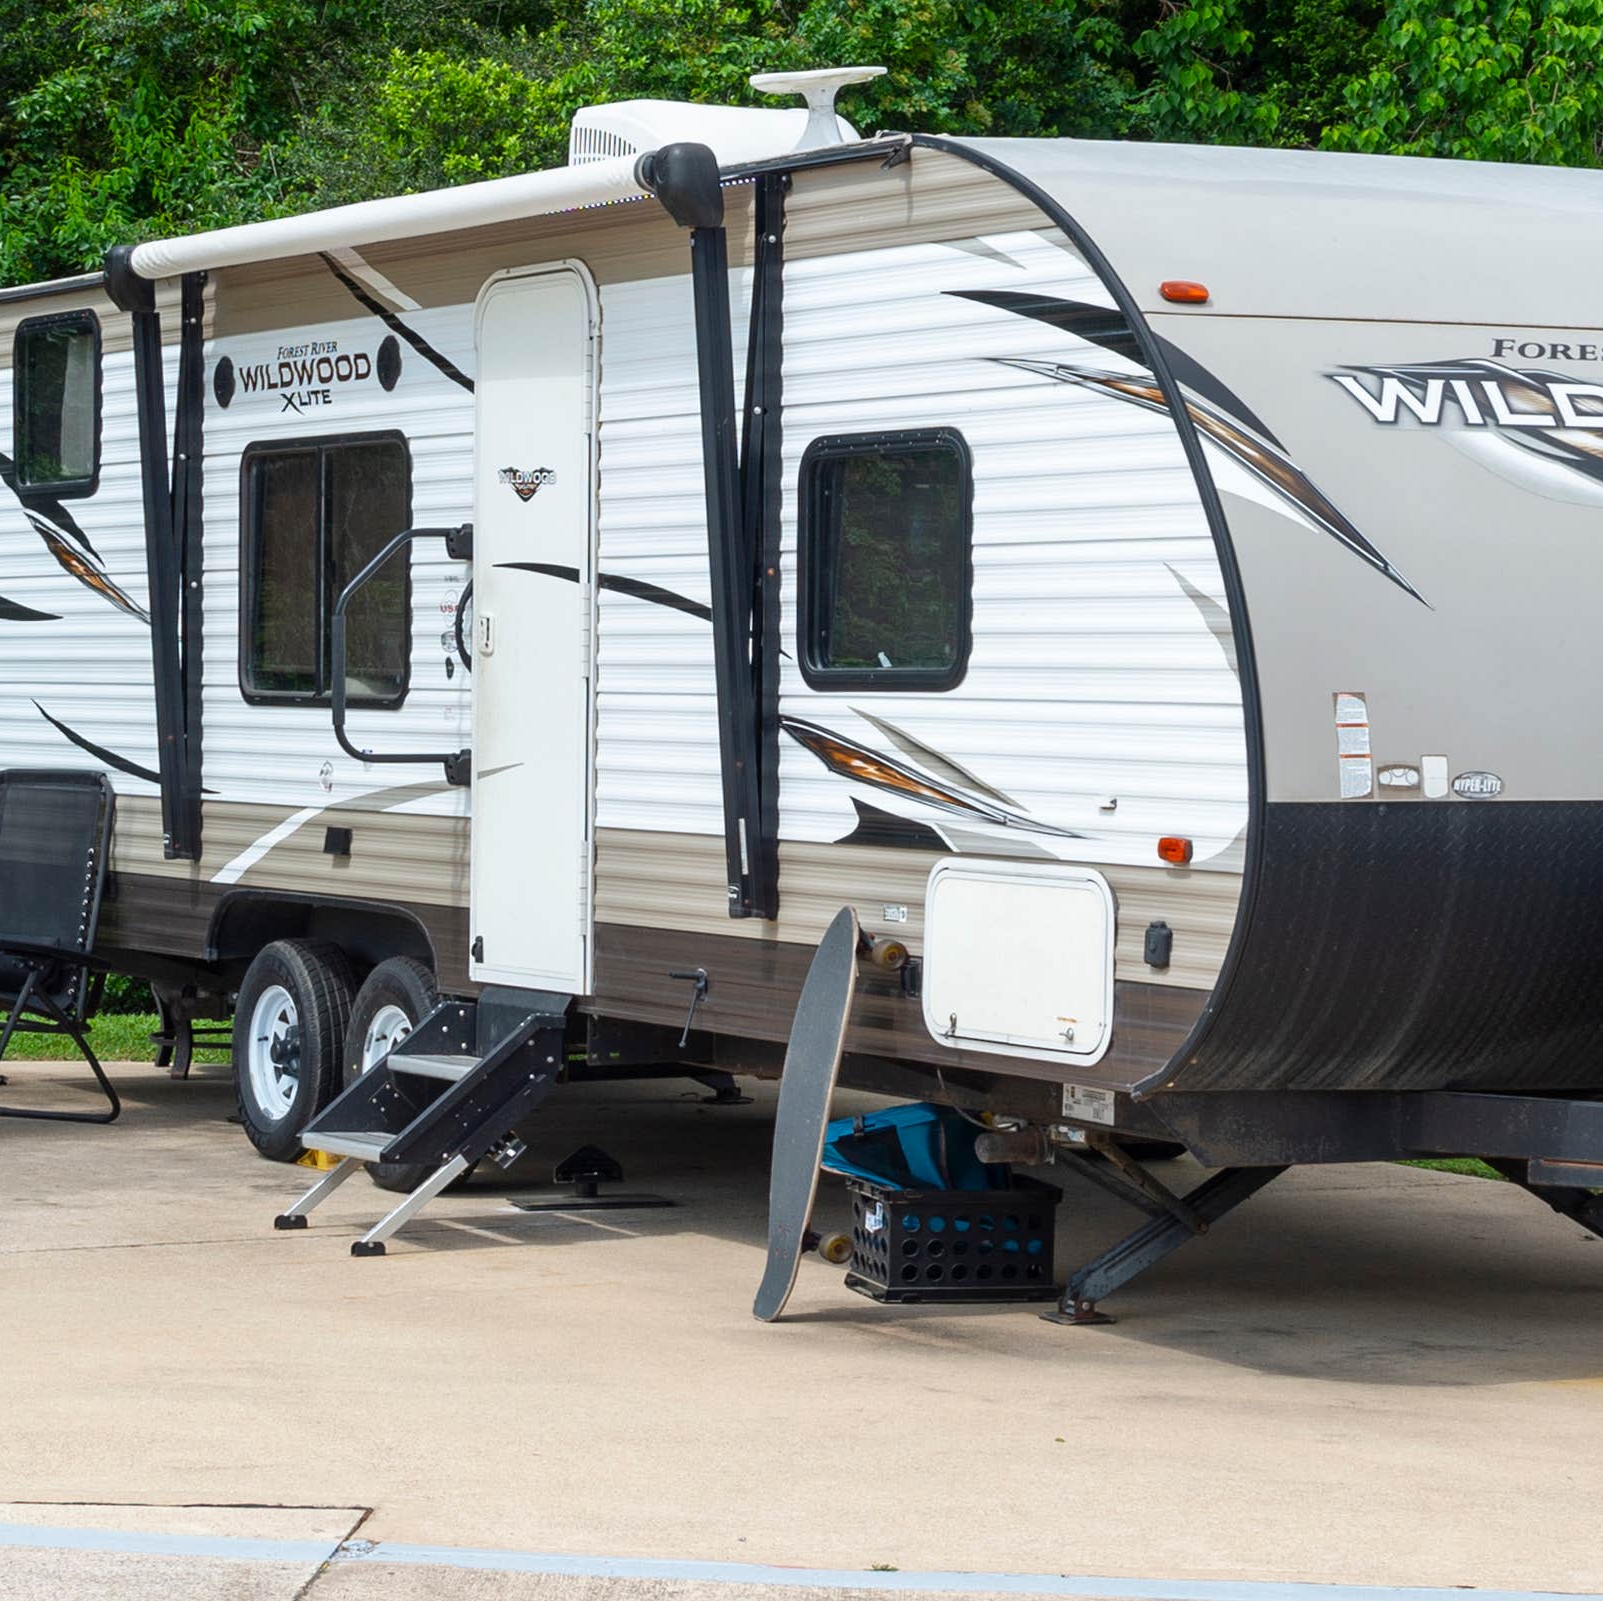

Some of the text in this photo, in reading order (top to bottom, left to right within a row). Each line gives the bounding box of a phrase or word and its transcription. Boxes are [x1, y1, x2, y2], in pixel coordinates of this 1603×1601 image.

[277, 341, 338, 360] FOREST RIVER
[239, 353, 371, 392] WILDWOOD
[498, 470, 558, 484] WILDWOOD
